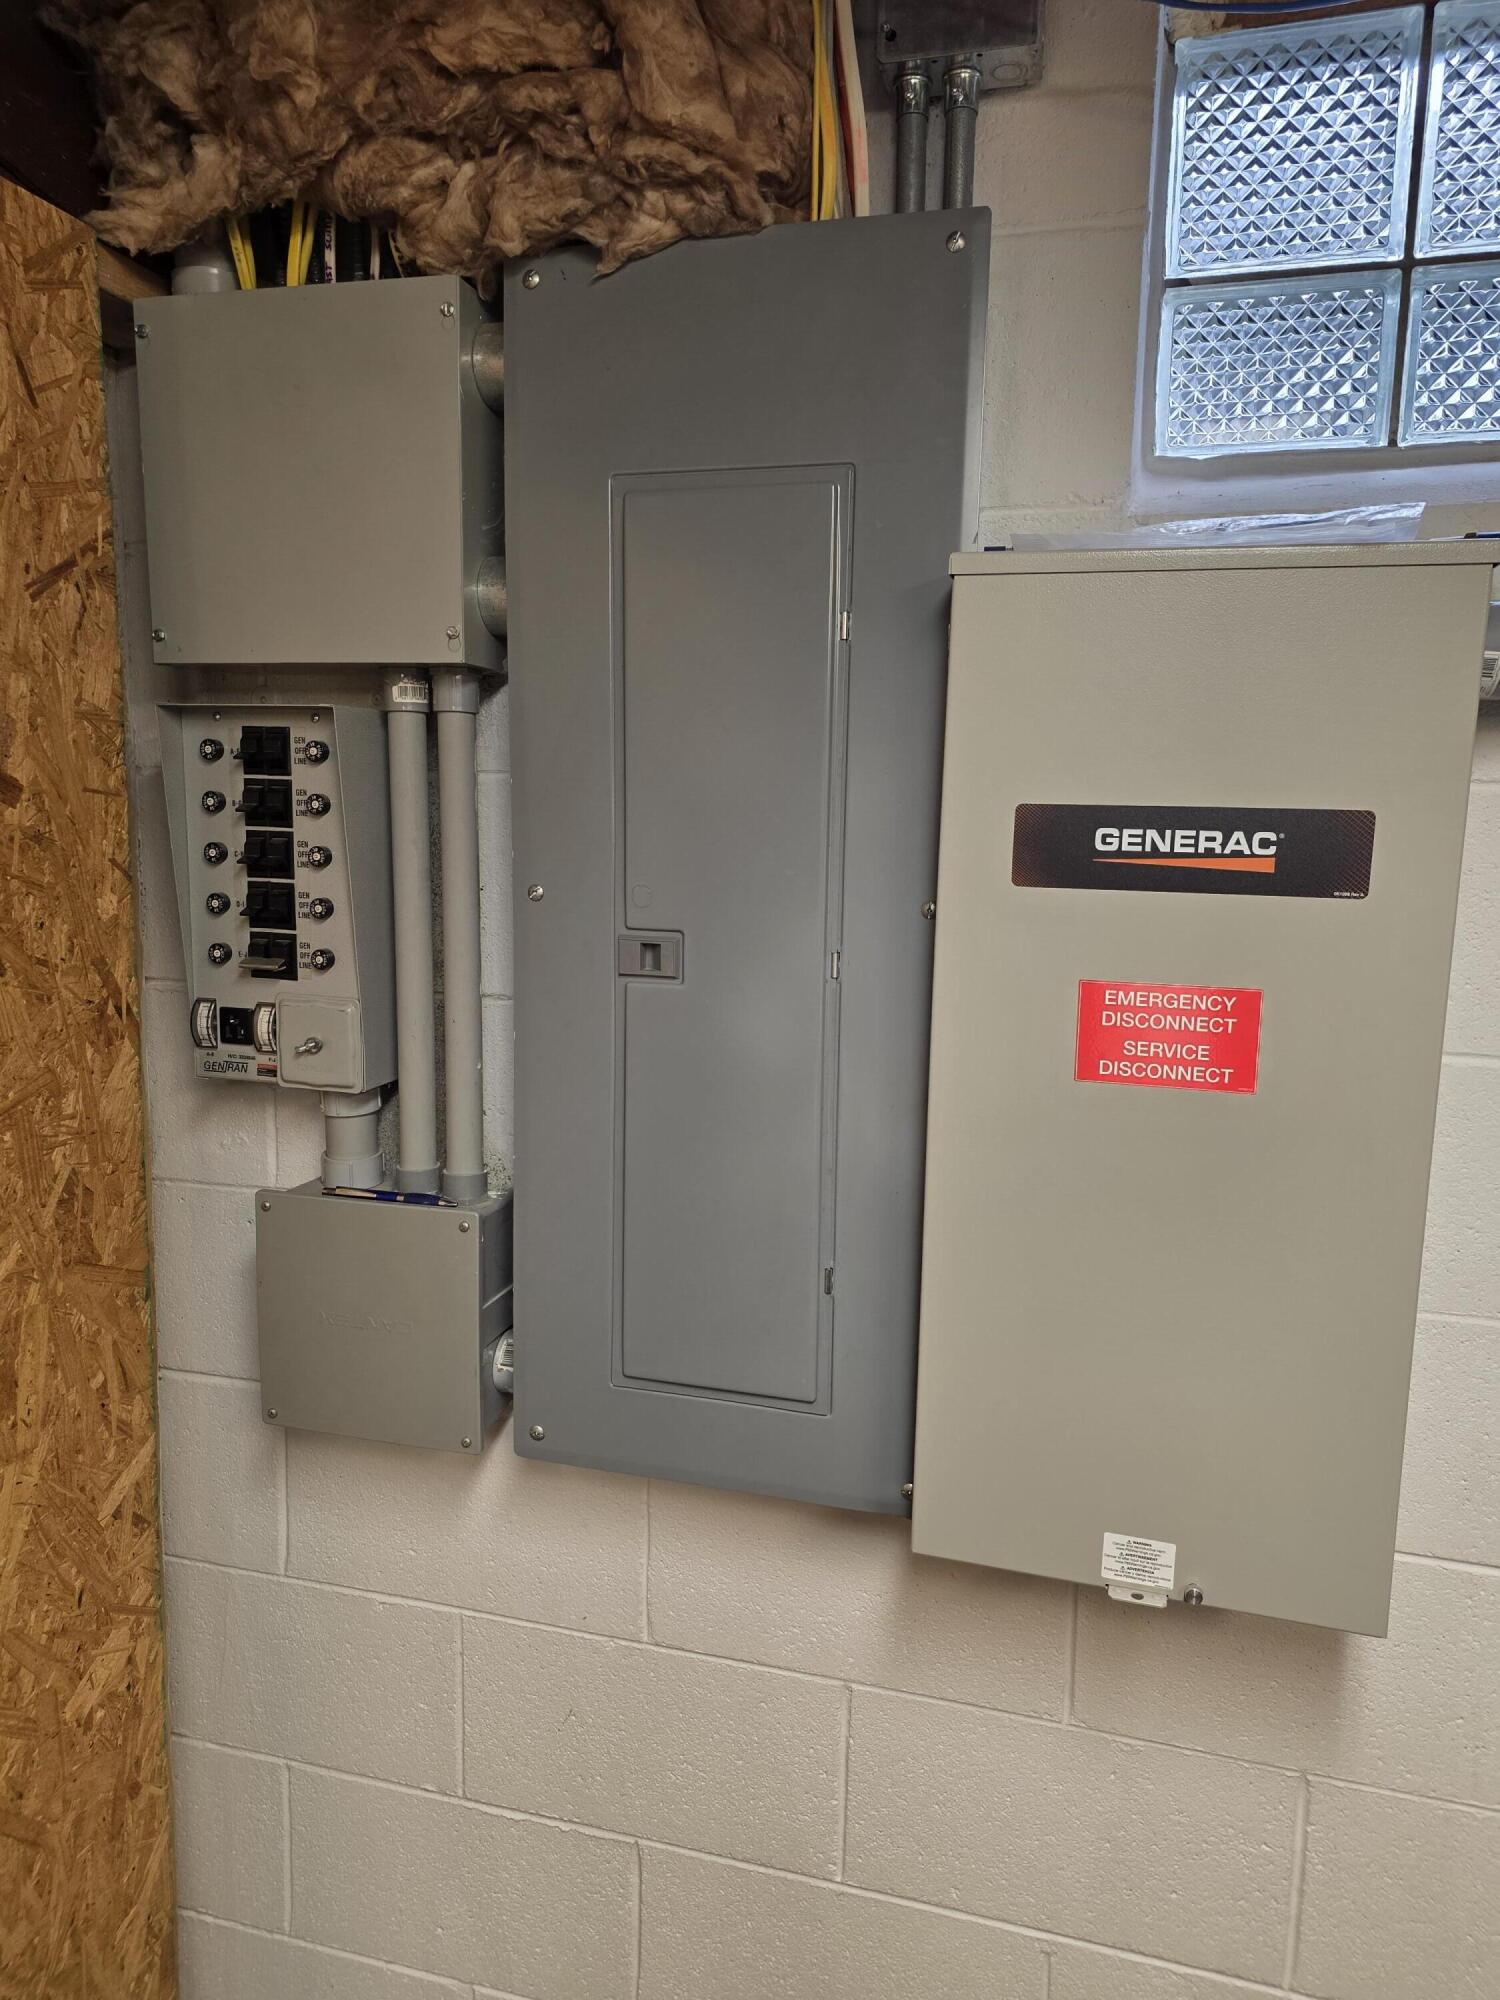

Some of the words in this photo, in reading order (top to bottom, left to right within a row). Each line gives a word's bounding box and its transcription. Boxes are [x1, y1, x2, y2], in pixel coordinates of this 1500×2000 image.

[1094, 828, 1277, 856] GENERAC
[1104, 990, 1237, 1012] EMERGENCY
[1101, 1011, 1238, 1034] DISCONNECT
[1123, 1040, 1210, 1061] SERVICE
[204, 1060, 248, 1073] GENTRAN
[1099, 1060, 1234, 1084] DISCONNECT
